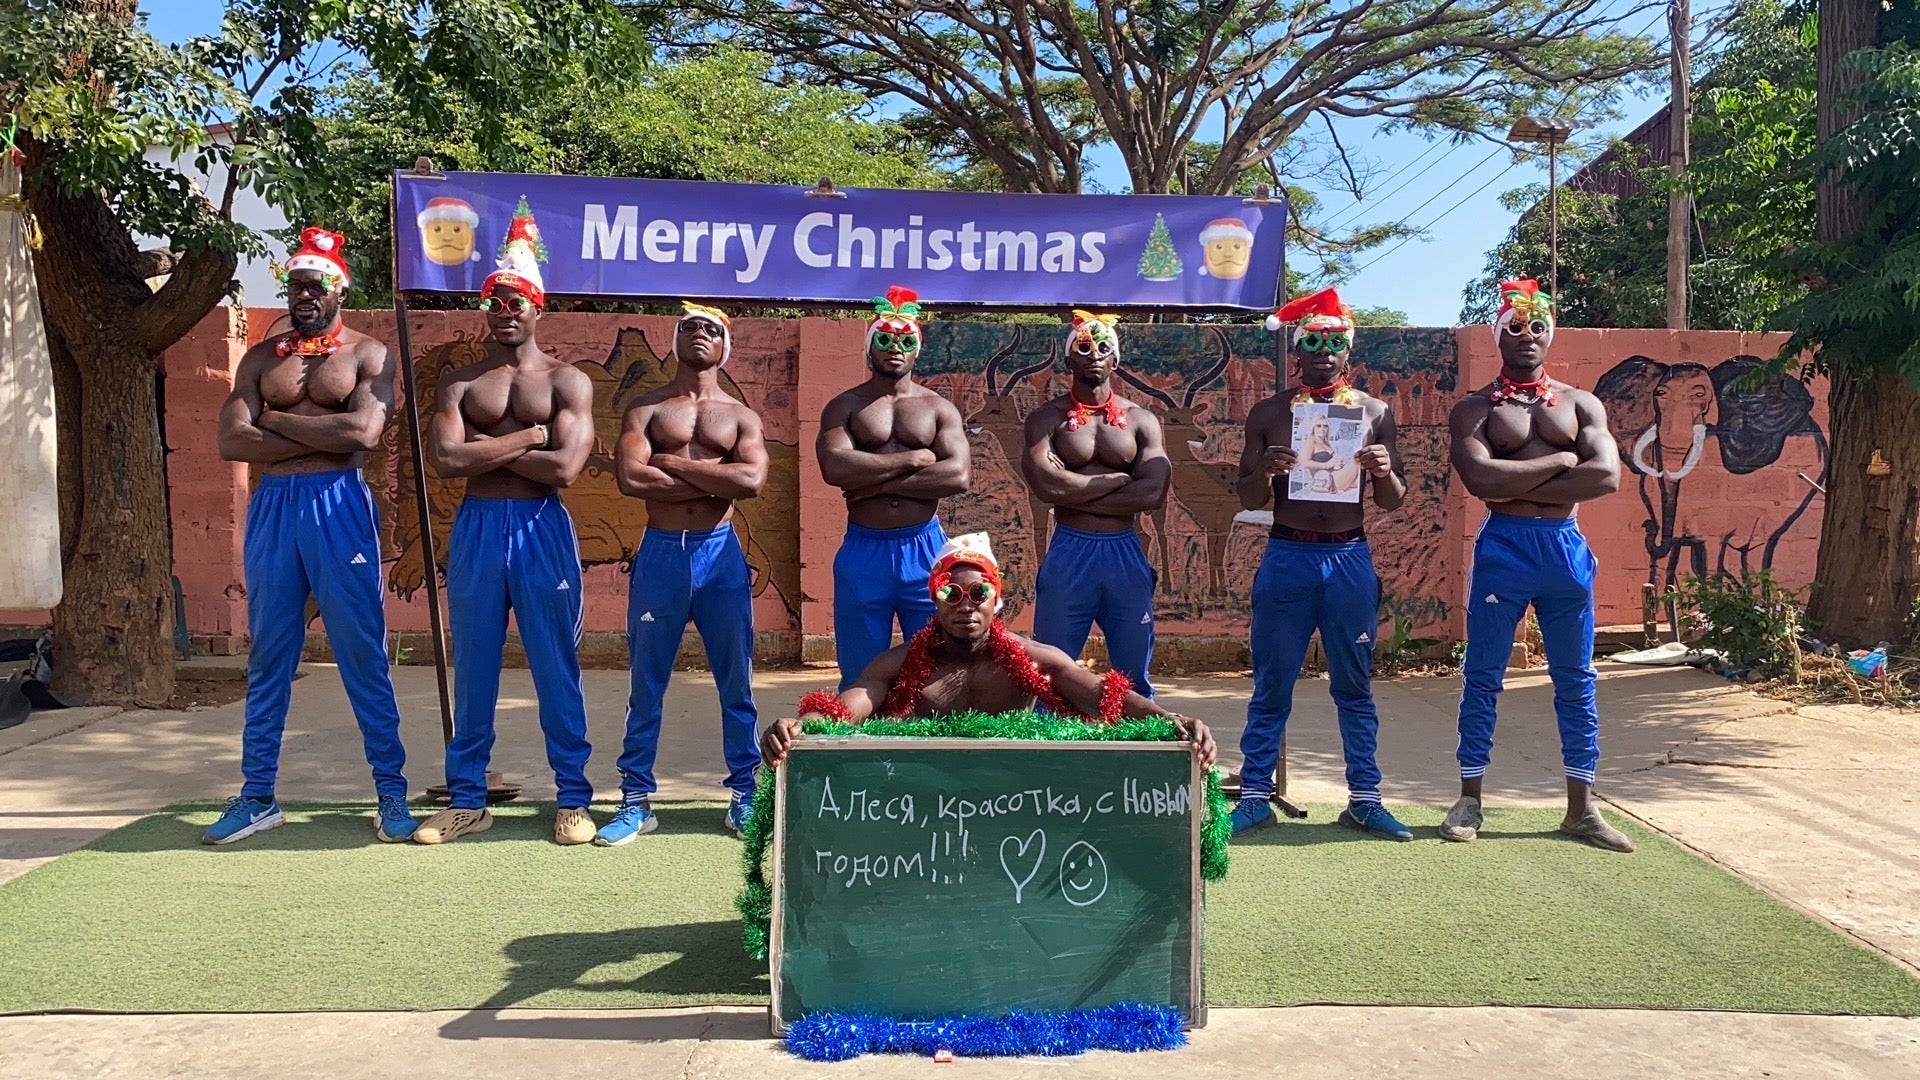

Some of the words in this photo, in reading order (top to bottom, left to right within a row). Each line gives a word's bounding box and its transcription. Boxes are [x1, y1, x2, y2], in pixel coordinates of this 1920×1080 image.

[581, 203, 777, 284] Merry
[793, 211, 1106, 274] Christmas
[817, 775, 929, 829] Алеся,
[938, 785, 1092, 837] красотка,
[1095, 791, 1114, 813] с
